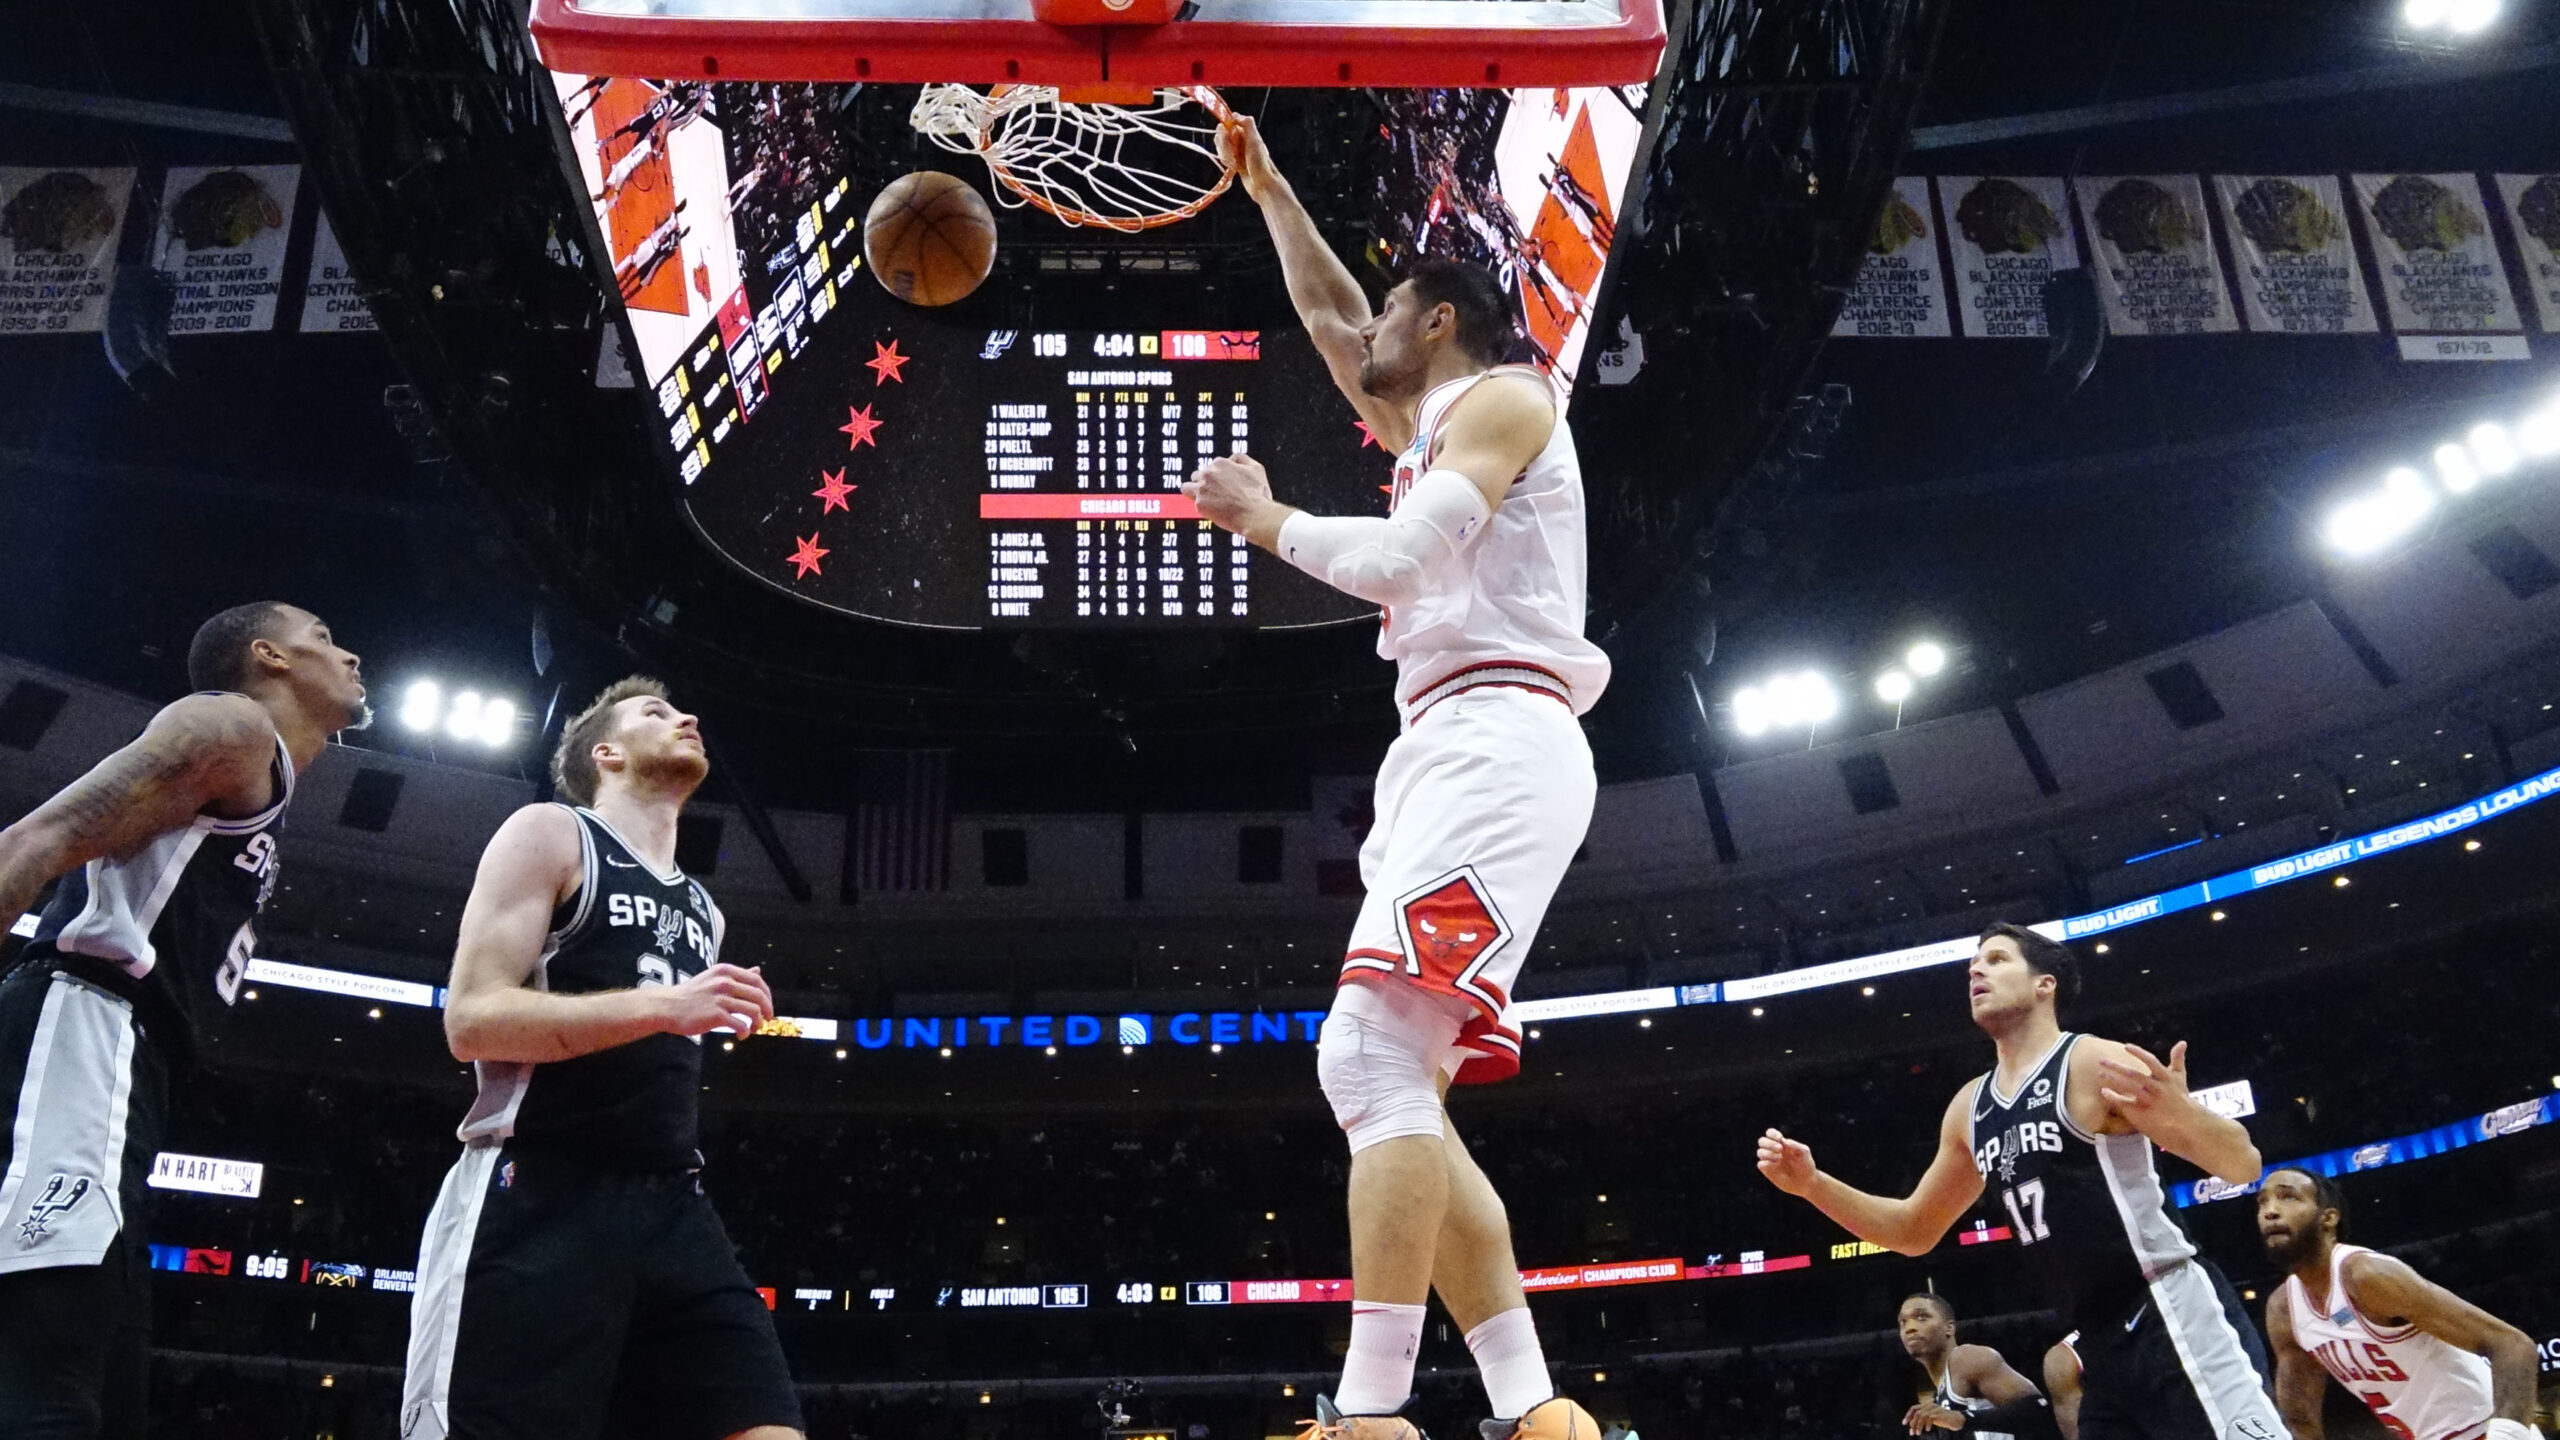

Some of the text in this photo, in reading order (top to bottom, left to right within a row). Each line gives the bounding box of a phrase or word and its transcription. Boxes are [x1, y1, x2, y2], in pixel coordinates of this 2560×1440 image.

[15, 252, 84, 267] CHICAGO
[184, 253, 252, 267] CHICAGO
[1863, 256, 1908, 269] ICAGO
[1985, 257, 2048, 270] CHICAGO
[0, 267, 99, 282] LACKHAWKS
[1857, 269, 1930, 282] CKHAWKS
[1969, 270, 2050, 283] BLACKHAW
[218, 283, 279, 297] DIVISION
[0, 299, 84, 314] HAMPIONS
[1843, 295, 1933, 308] ONFERENCE
[1841, 309, 1928, 322] CHAMPIONS
[1857, 322, 1915, 335] 2012-13
[1033, 334, 1066, 357] 105
[1094, 334, 1134, 357] 4:04
[1173, 335, 1206, 357] 106
[1067, 371, 1173, 385] SAN ANTONIO SPURS
[1100, 392, 1105, 403] F
[1115, 392, 1129, 403] PTS
[1134, 392, 1148, 403] REB
[1235, 392, 1244, 403] FT
[992, 405, 997, 419] 1
[999, 405, 1035, 419] WALKER
[1037, 405, 1047, 419] IV
[1077, 405, 1089, 419] 21
[1198, 405, 1213, 419] 2/4
[986, 422, 997, 436] 31
[1078, 422, 1087, 436] 11
[1100, 422, 1105, 436] 1
[1162, 422, 1177, 436] 4/7
[999, 440, 1033, 454] POELTL
[1099, 440, 1106, 454] 2
[1138, 440, 1144, 454] 7
[987, 457, 997, 471] 17
[999, 457, 1053, 471] MCDERMOTT
[1137, 457, 1145, 471] 4
[999, 475, 1036, 489] MURRAY
[1100, 475, 1105, 489] 1
[1163, 475, 1182, 489] 7/14
[1080, 500, 1161, 514] CHICAGO BULLS
[1101, 520, 1106, 531] F
[1115, 520, 1129, 531] PTS
[1135, 520, 1149, 531] REB
[1000, 533, 1029, 547] JONES
[1100, 533, 1105, 547] 1
[1118, 533, 1126, 547] 4
[1138, 533, 1144, 547] 7
[1162, 533, 1177, 547] 2/7
[992, 550, 998, 564] 7
[1000, 550, 1033, 564] BROWN
[1078, 550, 1089, 564] 27
[1099, 550, 1106, 564] 2
[1198, 550, 1213, 564] 2/3
[1000, 568, 1038, 582] VUCEVIC
[1078, 568, 1089, 582] 31
[1099, 568, 1106, 582] 2
[1117, 568, 1127, 582] 21
[1199, 568, 1213, 582] 1/7
[988, 585, 998, 599] 12
[1000, 585, 1043, 599] DOSUNMU
[1078, 585, 1090, 599] 34
[1099, 585, 1107, 599] 4
[1117, 585, 1128, 599] 12
[1200, 585, 1213, 599] 1/4
[1233, 585, 1248, 599] 1/2
[1001, 602, 1030, 616] WHITE
[1099, 602, 1107, 616] 4
[1138, 602, 1145, 616] 4
[1232, 602, 1248, 616] 4/4
[2254, 862, 2296, 884] BUD
[2296, 843, 2353, 873] LIGHT
[2357, 805, 2480, 855] LEGENDS
[2068, 899, 2159, 936] BUD LIGHT
[215, 917, 257, 1006] 5
[1750, 948, 1955, 992] THE ORIGINAL CHICAGO STYLE POPCORN
[262, 967, 313, 982] CHICAGO
[318, 977, 348, 987] STYLE
[353, 981, 405, 996] POPCORN
[1521, 996, 1650, 1015] CHICAGO STYLE POPCORN
[856, 1012, 1326, 1048] UNITED CENT
[2027, 1093, 2053, 1110] Frost
[175, 1159, 217, 1181] HART
[2002, 1177, 2050, 1246] 17
[1831, 1241, 1890, 1260] FAST BRE
[246, 1255, 288, 1279] 9:05
[1584, 1266, 1647, 1283] CHAMPIONS
[1648, 1264, 1676, 1277] CLUB
[374, 1268, 414, 1282] ORLANDO
[373, 1279, 407, 1292] DENVER
[795, 1288, 832, 1300] TIMEOUTS
[870, 1288, 894, 1299] FOULS
[961, 1289, 986, 1306] SAN
[987, 1287, 1039, 1306] ANTONIO
[1054, 1287, 1079, 1304] 105
[1117, 1283, 1153, 1303] 4:03
[1197, 1284, 1221, 1301] 106
[1248, 1282, 1299, 1300] CHICAGO
[809, 1299, 817, 1310] 2
